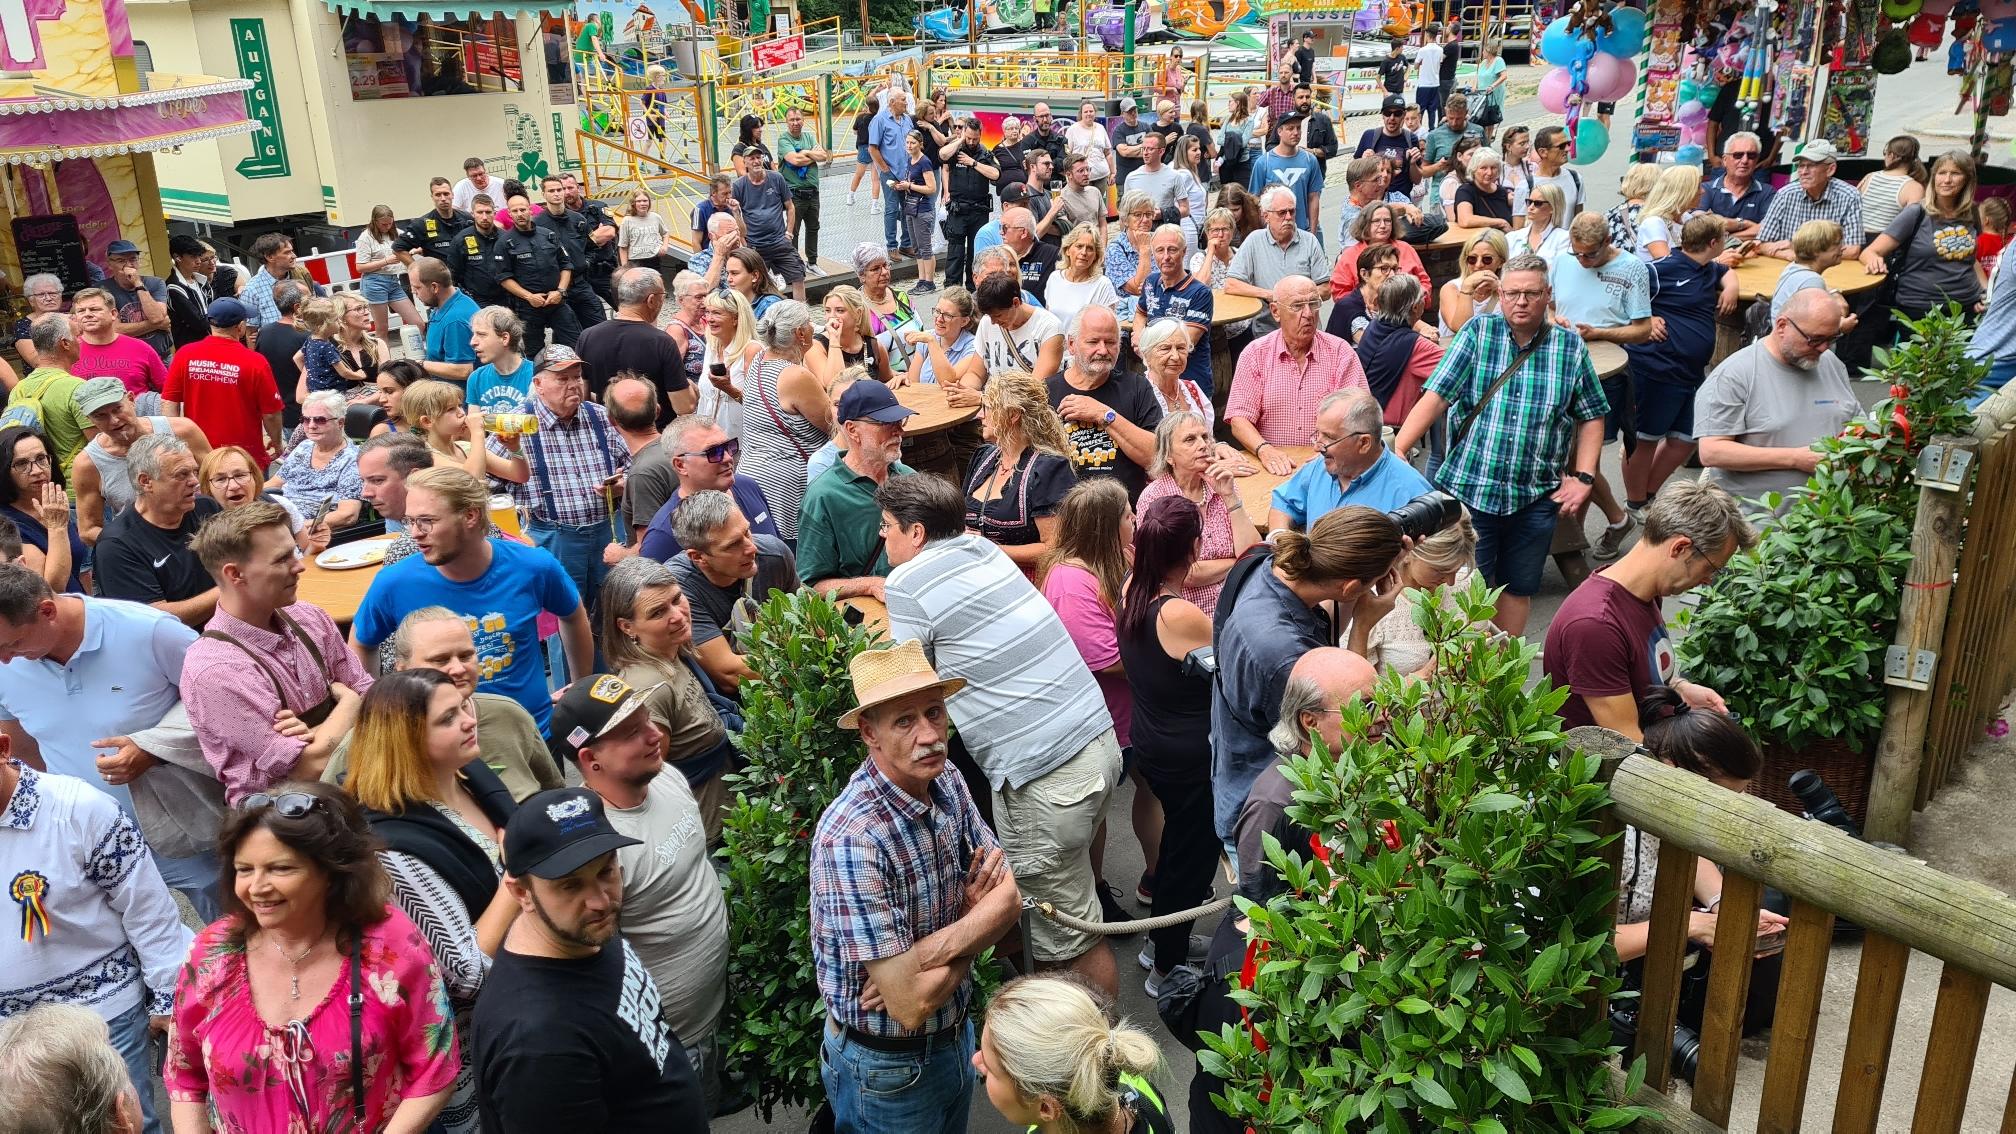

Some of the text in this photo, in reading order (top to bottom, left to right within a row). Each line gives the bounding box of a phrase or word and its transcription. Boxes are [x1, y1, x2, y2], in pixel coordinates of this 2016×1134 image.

[1292, 10, 1352, 20] KASSE
[352, 75, 375, 86] 2.29
[245, 29, 276, 156] AUSGANG
[553, 114, 566, 168] EINGANG
[1605, 283, 1622, 297] 62
[188, 366, 239, 378] SPIELMANNSZUG
[189, 359, 240, 373] MUSIK- UND
[189, 372, 238, 385] FORCHHEIM
